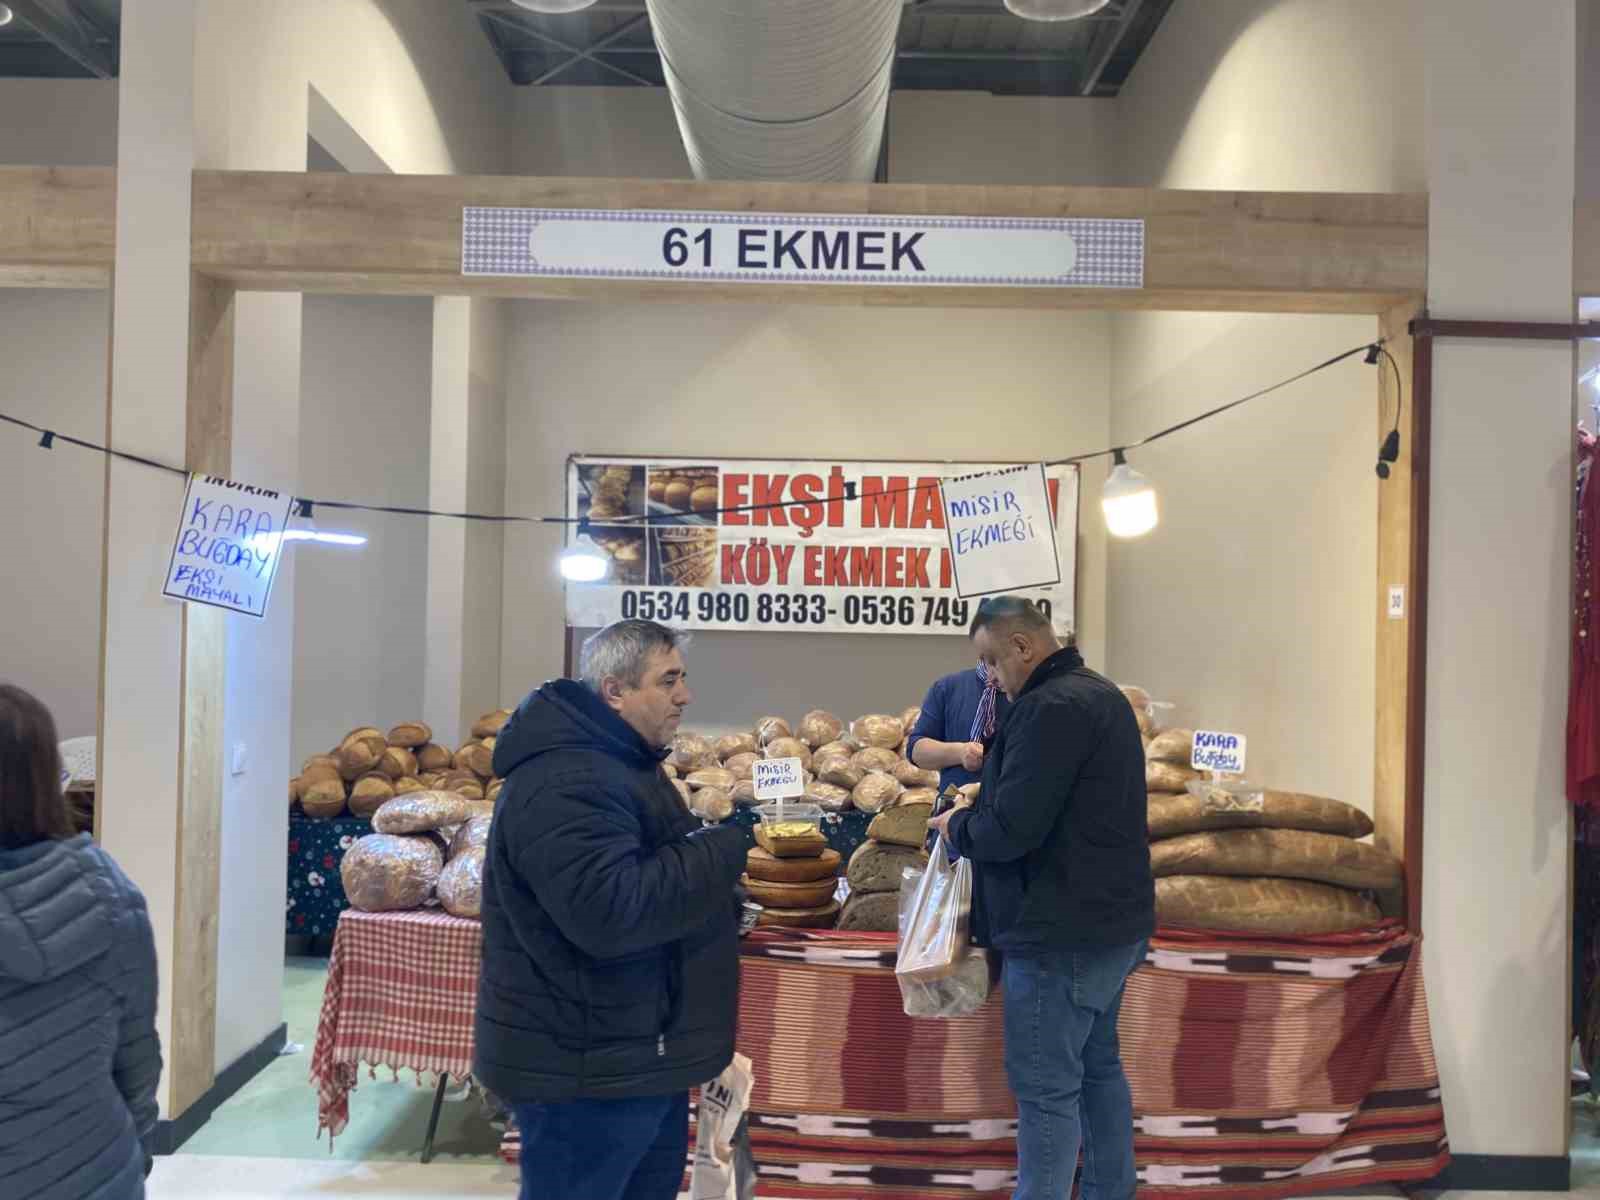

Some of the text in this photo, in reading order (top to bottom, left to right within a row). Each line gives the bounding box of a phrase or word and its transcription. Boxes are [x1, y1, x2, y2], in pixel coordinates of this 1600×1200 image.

[662, 227, 926, 272] 61 EKMEK
[189, 497, 273, 541] KARA
[721, 465, 845, 538] EKŞİ
[720, 537, 796, 587] KÖY
[803, 545, 932, 589] EKMEK
[621, 590, 690, 621] 0534
[697, 591, 749, 622] 980
[843, 595, 915, 625] 0536
[921, 596, 968, 626] 749
[1195, 732, 1238, 750] KARA
